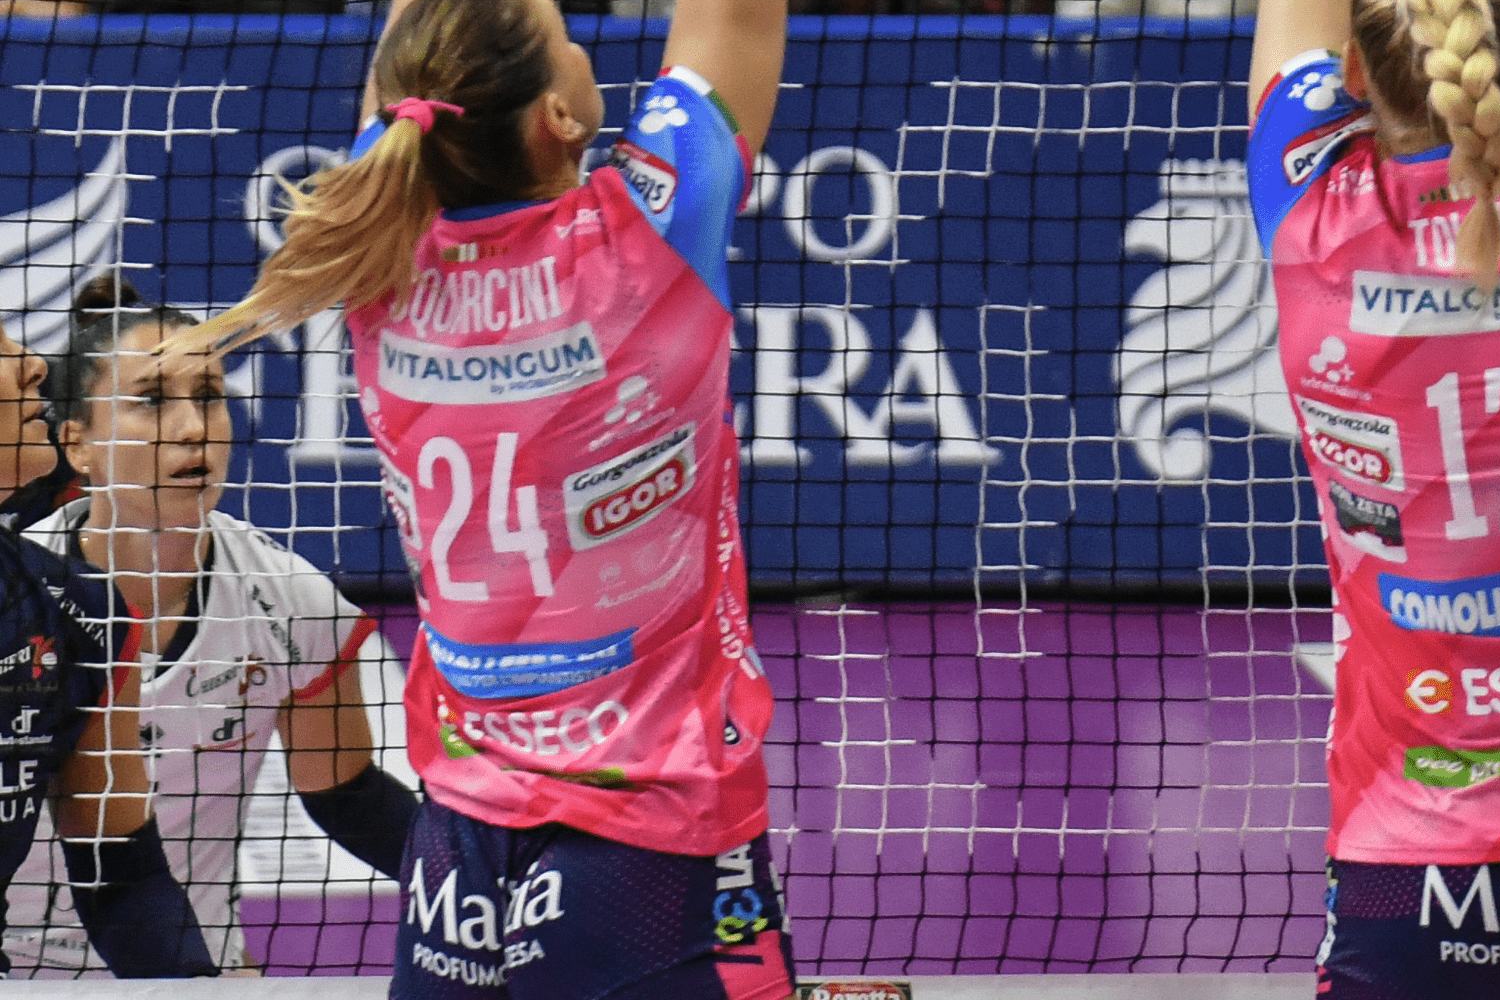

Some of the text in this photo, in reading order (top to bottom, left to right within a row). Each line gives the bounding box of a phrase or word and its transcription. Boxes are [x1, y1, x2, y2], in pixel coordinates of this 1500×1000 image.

[389, 255, 564, 338] QUARCINI
[384, 336, 595, 381] VITALONGUM
[417, 432, 555, 603] 24
[592, 466, 679, 531] IGOR
[463, 700, 629, 756] ESSECO
